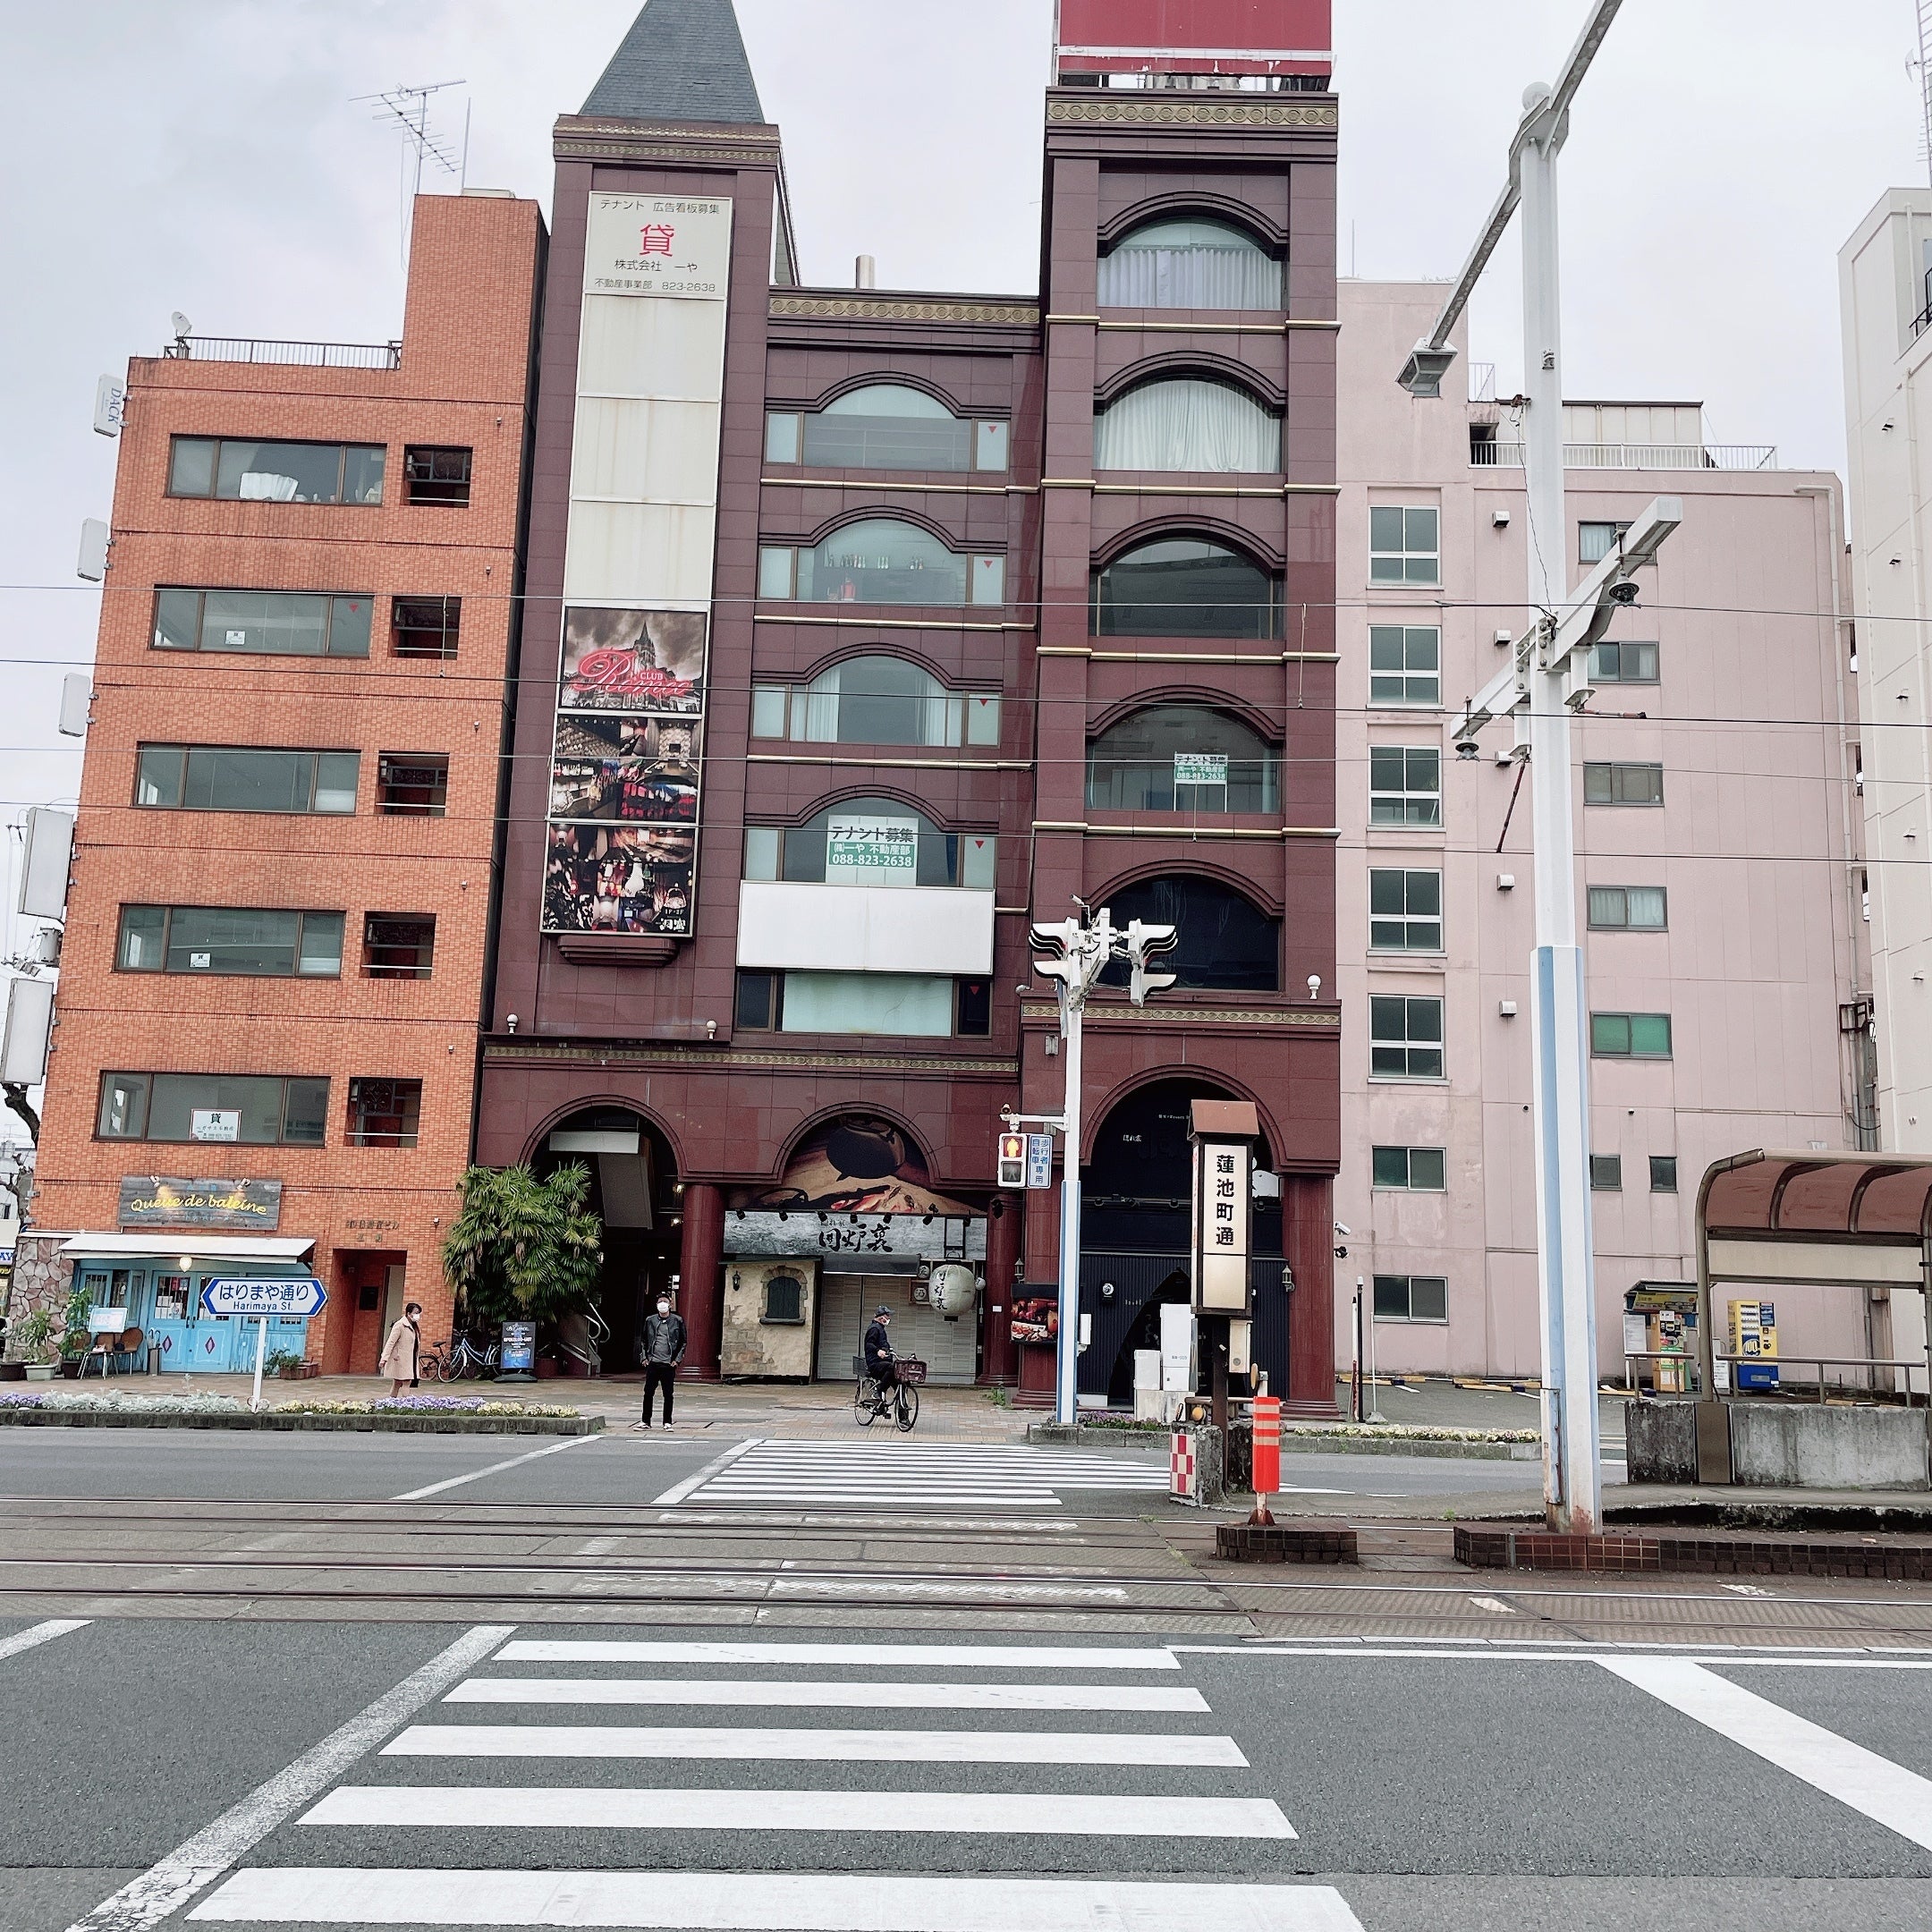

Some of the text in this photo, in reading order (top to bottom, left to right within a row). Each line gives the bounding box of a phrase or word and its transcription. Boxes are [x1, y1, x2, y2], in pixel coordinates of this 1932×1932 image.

[600, 199, 720, 215] テナント 広告看板募集
[639, 224, 675, 257] 貸
[614, 259, 663, 272] 株式会社
[594, 277, 716, 292] 不動産事業部 823-2638
[640, 672, 664, 681] CLUB
[832, 826, 914, 843] テナント募集
[869, 843, 911, 856] 不動産部
[832, 854, 912, 867] 088-823-2638
[131, 1194, 267, 1216] Queue de baleine
[1216, 1154, 1235, 1246] 蓮池町通
[219, 1284, 309, 1301] はりまや通り
[233, 1301, 293, 1313] Harimaya St.
